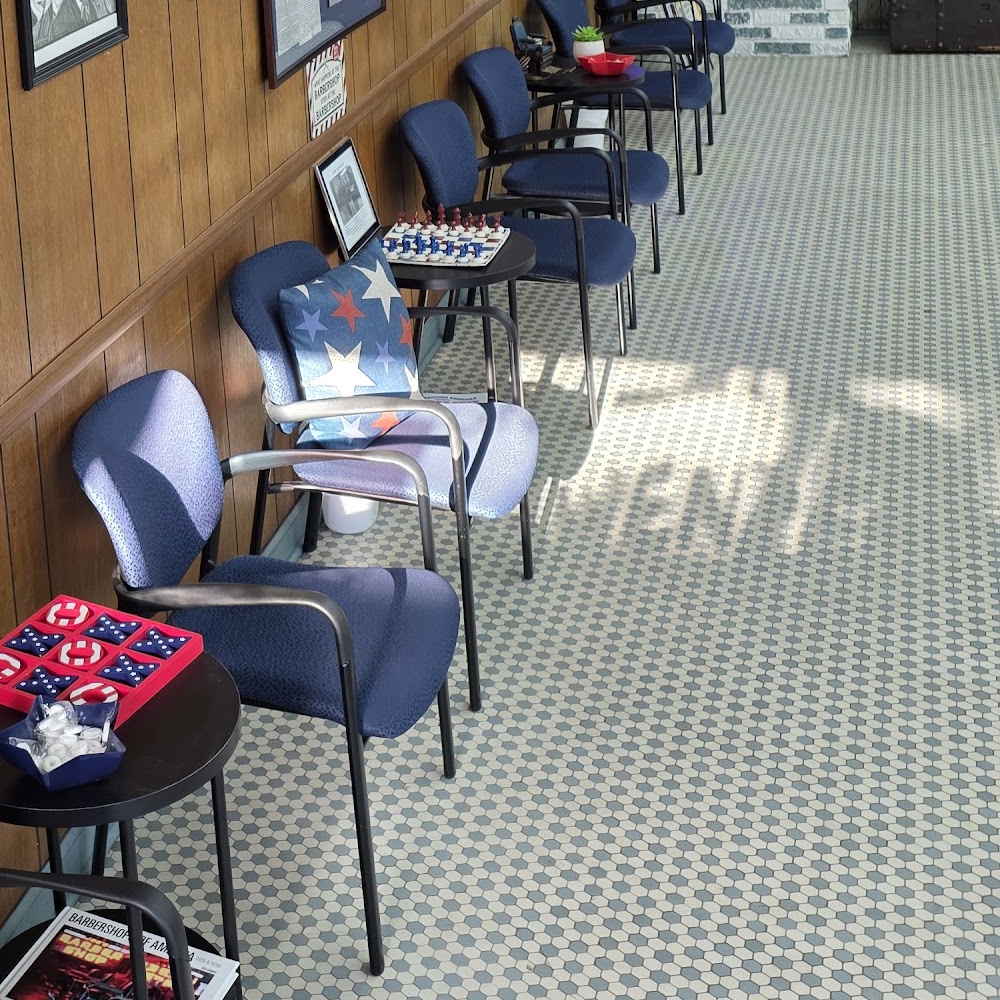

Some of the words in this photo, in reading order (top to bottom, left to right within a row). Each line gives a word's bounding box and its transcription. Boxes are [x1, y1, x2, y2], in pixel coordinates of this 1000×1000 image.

[68, 912, 130, 940] BARBERSHOP
[58, 933, 124, 961] BARBER
[63, 946, 109, 965] SHOP
